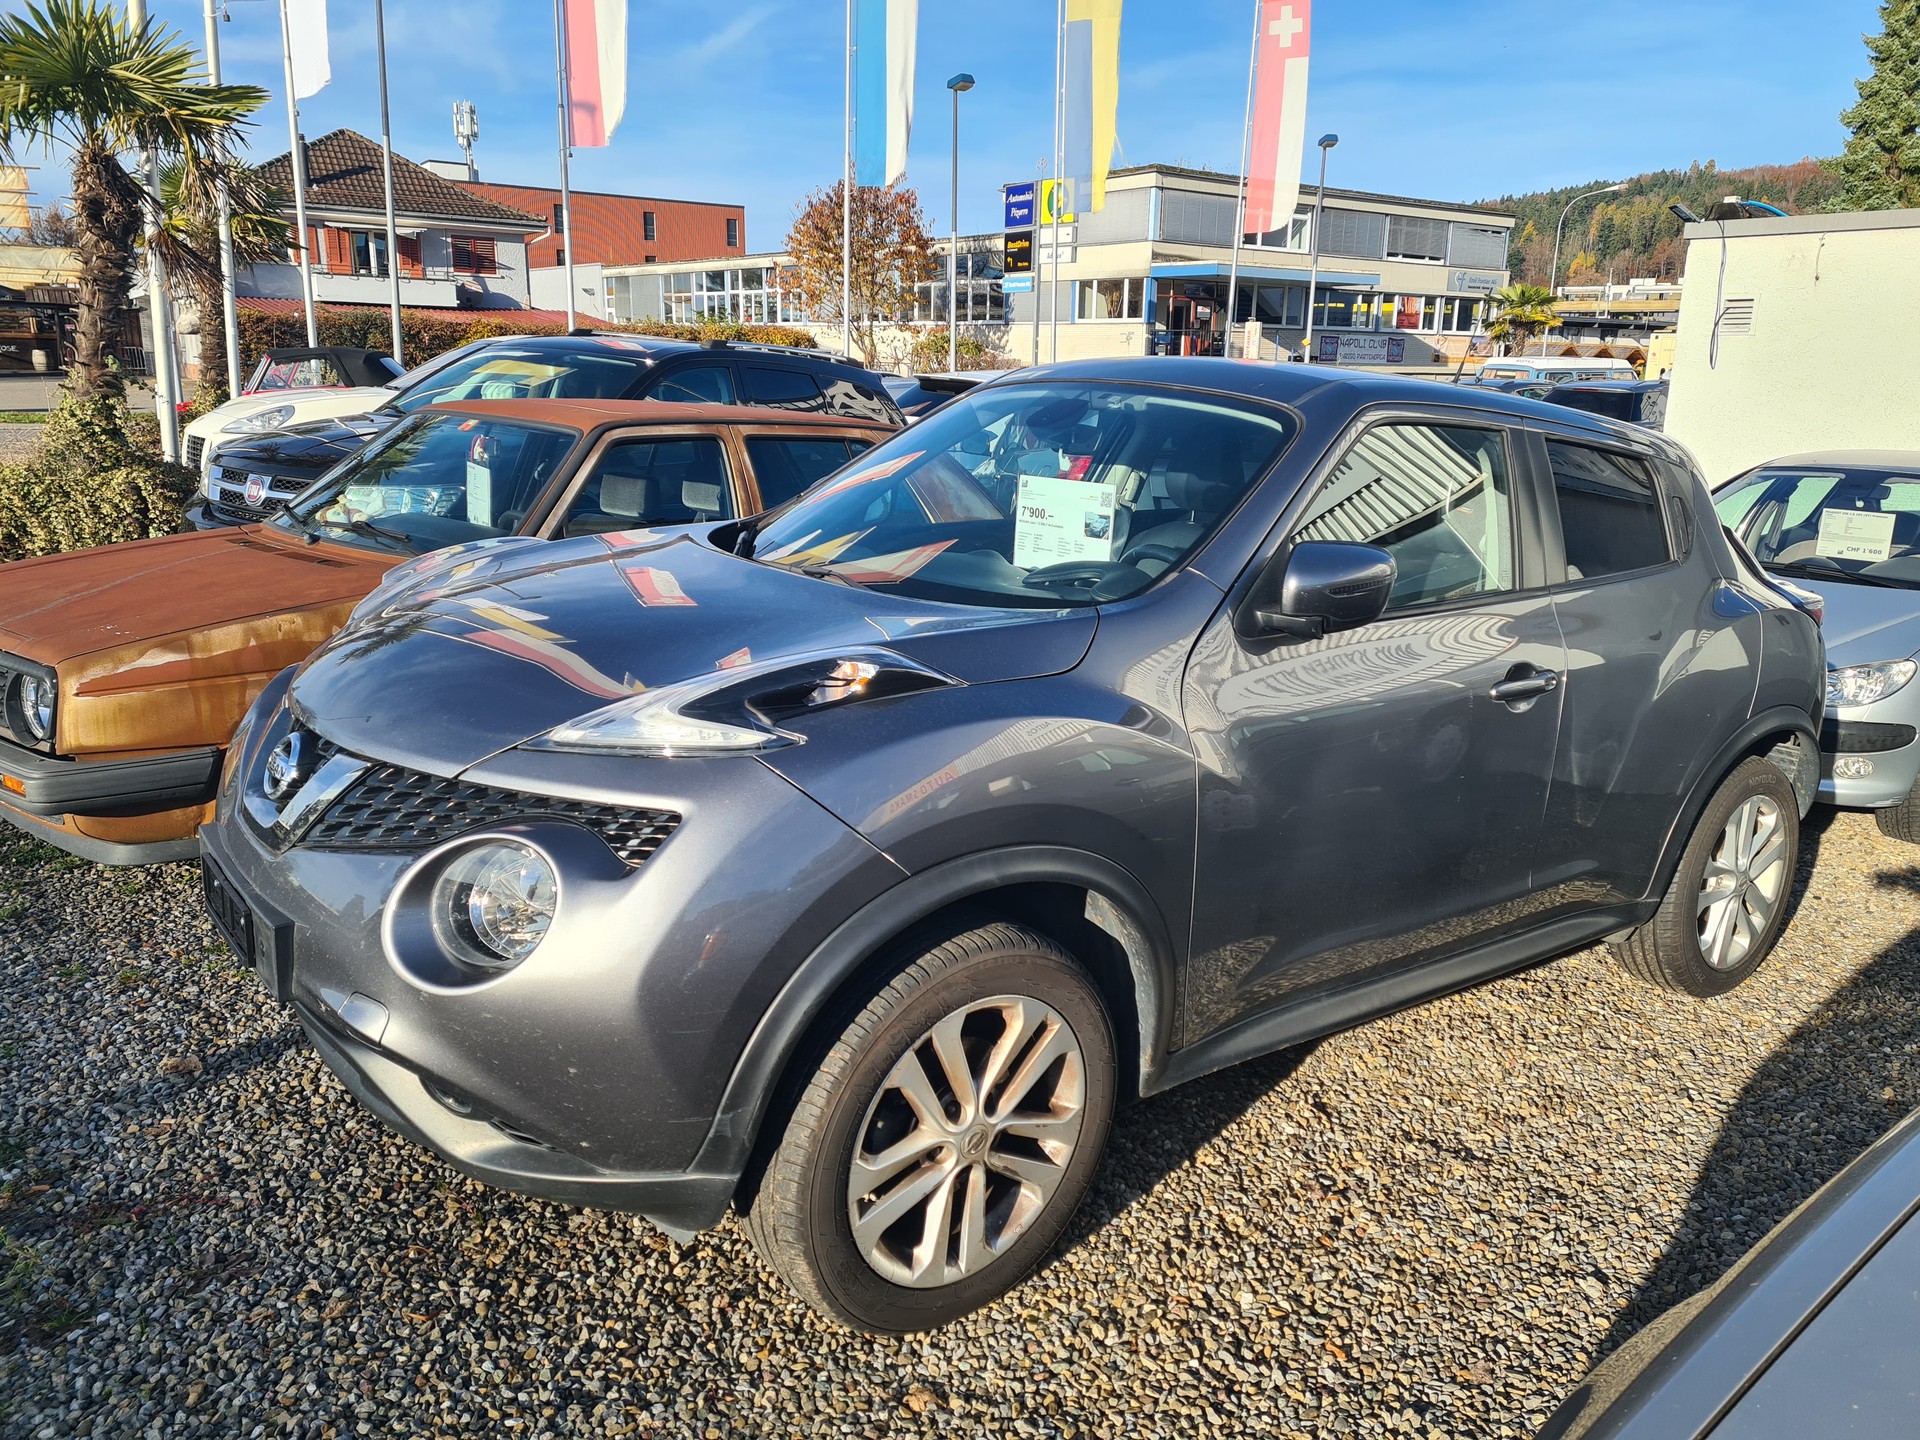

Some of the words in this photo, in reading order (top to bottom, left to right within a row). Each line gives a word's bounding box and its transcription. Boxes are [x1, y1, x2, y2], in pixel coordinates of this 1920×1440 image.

[1007, 239, 1030, 250] BestDrive
[1339, 338, 1367, 349] NAPOLI
[1368, 339, 1387, 349] CLUB
